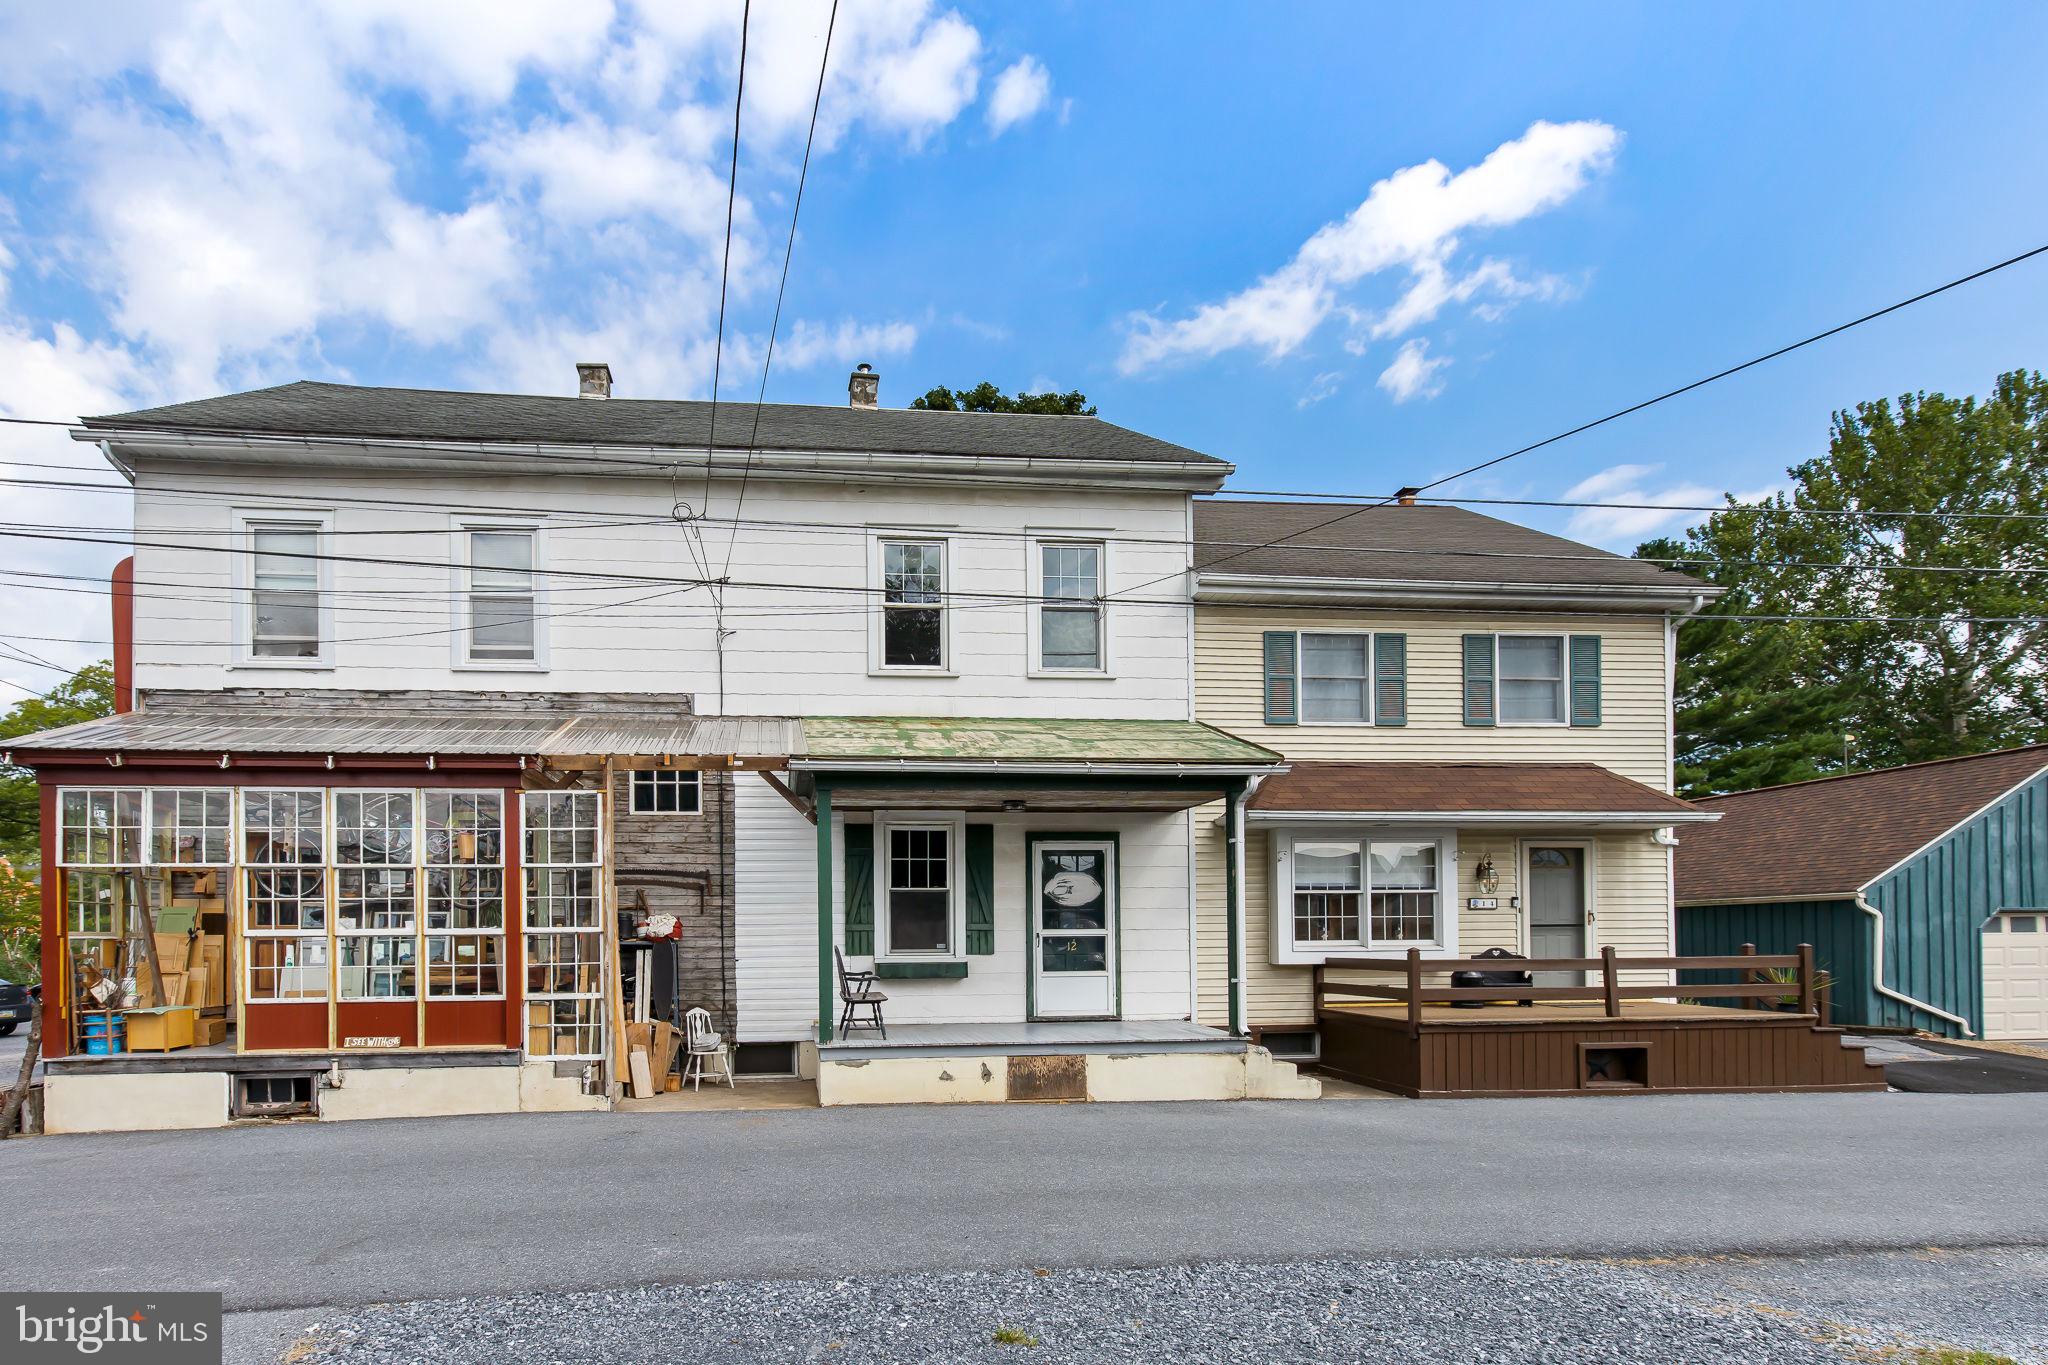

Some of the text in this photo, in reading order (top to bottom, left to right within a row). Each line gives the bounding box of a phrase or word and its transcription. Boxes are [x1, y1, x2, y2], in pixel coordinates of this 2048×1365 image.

[1066, 941, 1078, 952] 12
[344, 1037, 351, 1048] I
[350, 1037, 367, 1047] SEE
[367, 1037, 387, 1047] WITH
